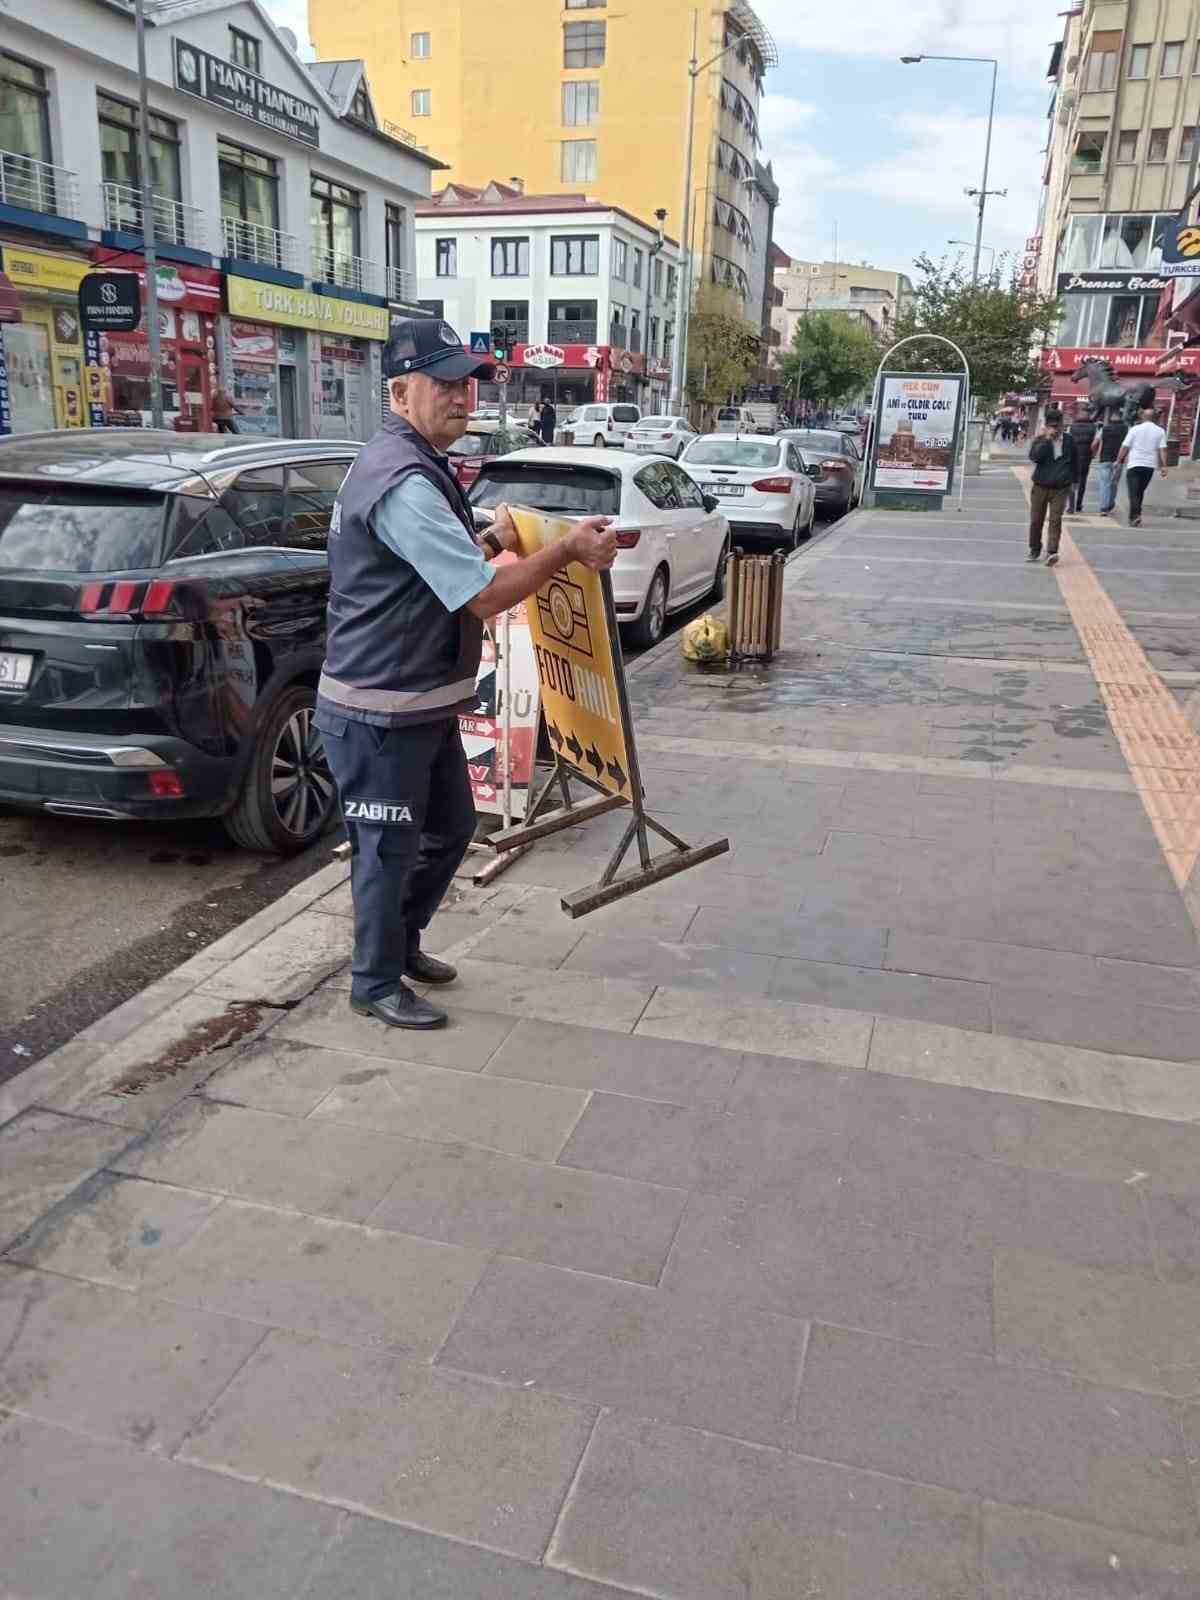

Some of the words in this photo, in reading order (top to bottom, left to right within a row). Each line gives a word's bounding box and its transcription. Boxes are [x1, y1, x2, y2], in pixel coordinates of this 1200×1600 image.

[234, 99, 254, 117] CAFE
[258, 109, 299, 137] RESTAURANT
[1064, 273, 1126, 291] Prenses
[297, 297, 334, 321] HAVA
[337, 305, 385, 331] YOLLARI
[1115, 355, 1142, 366] MİNİ
[344, 801, 413, 822] ZABITA
